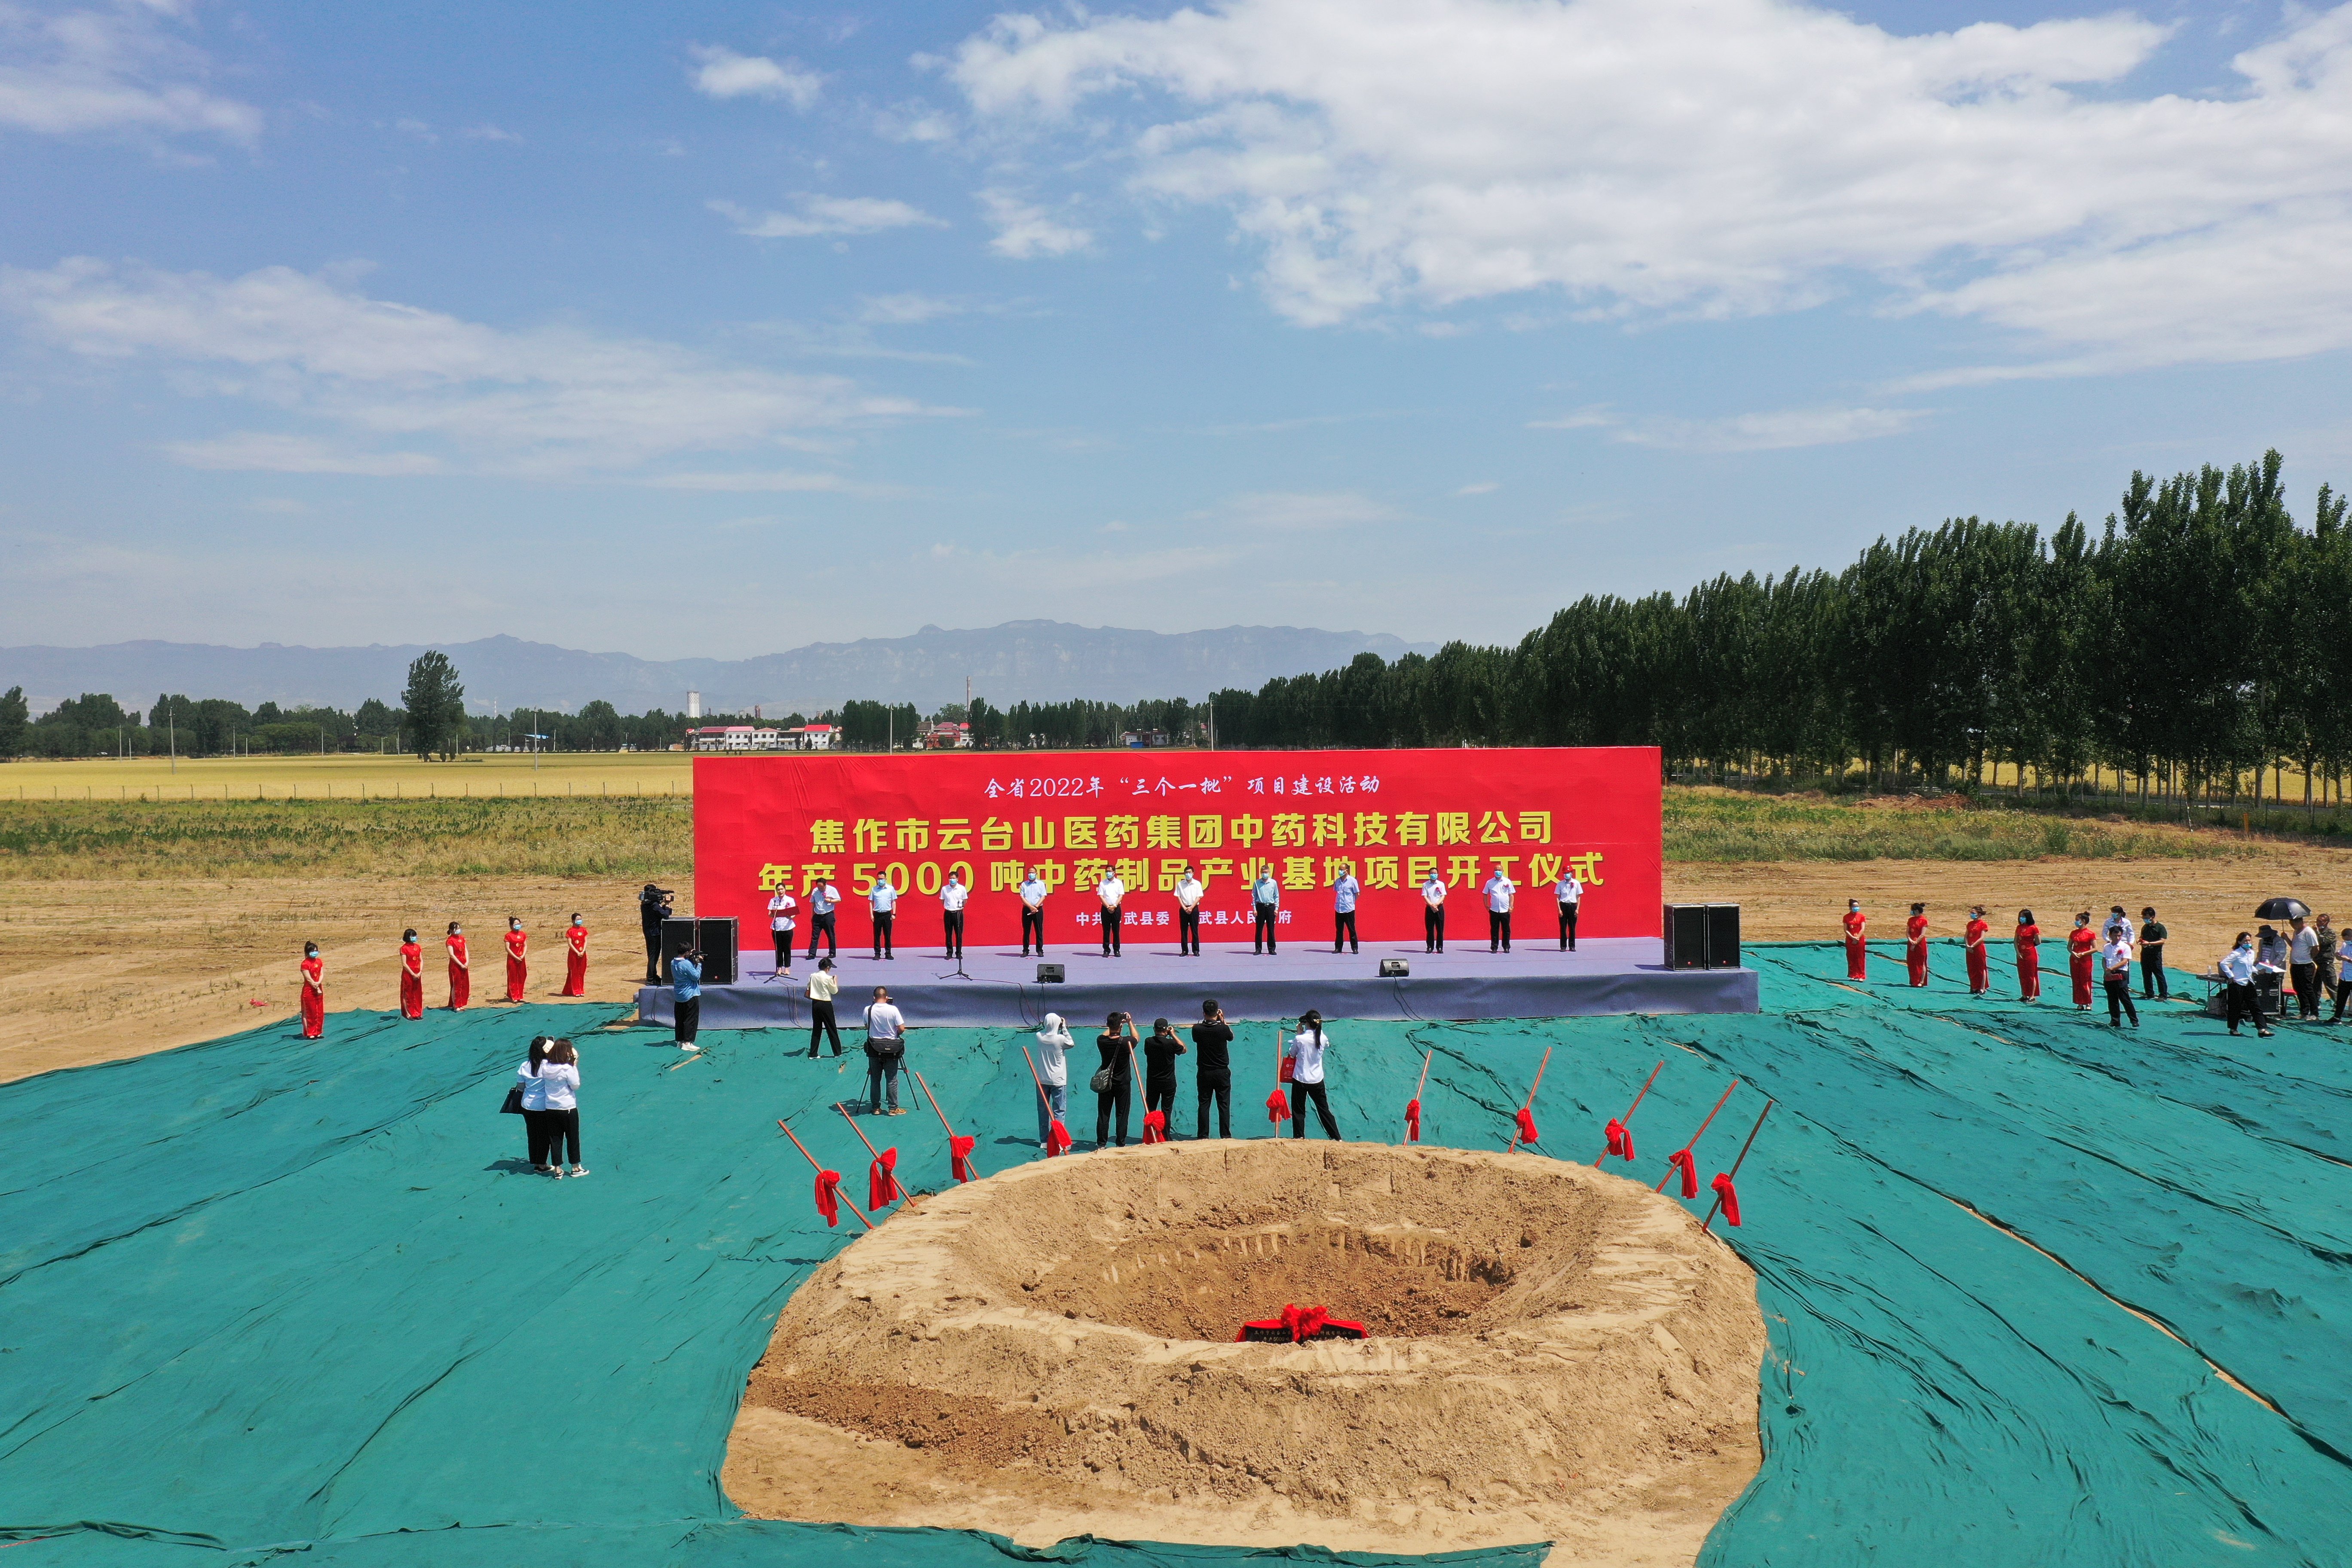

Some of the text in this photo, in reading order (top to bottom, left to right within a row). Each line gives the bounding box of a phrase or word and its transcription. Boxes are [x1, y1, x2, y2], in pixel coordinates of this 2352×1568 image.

[810, 811, 1551, 853] 焦作市云台山医药集团中药科技有限公司
[1076, 911, 1170, 926] 中共武县委
